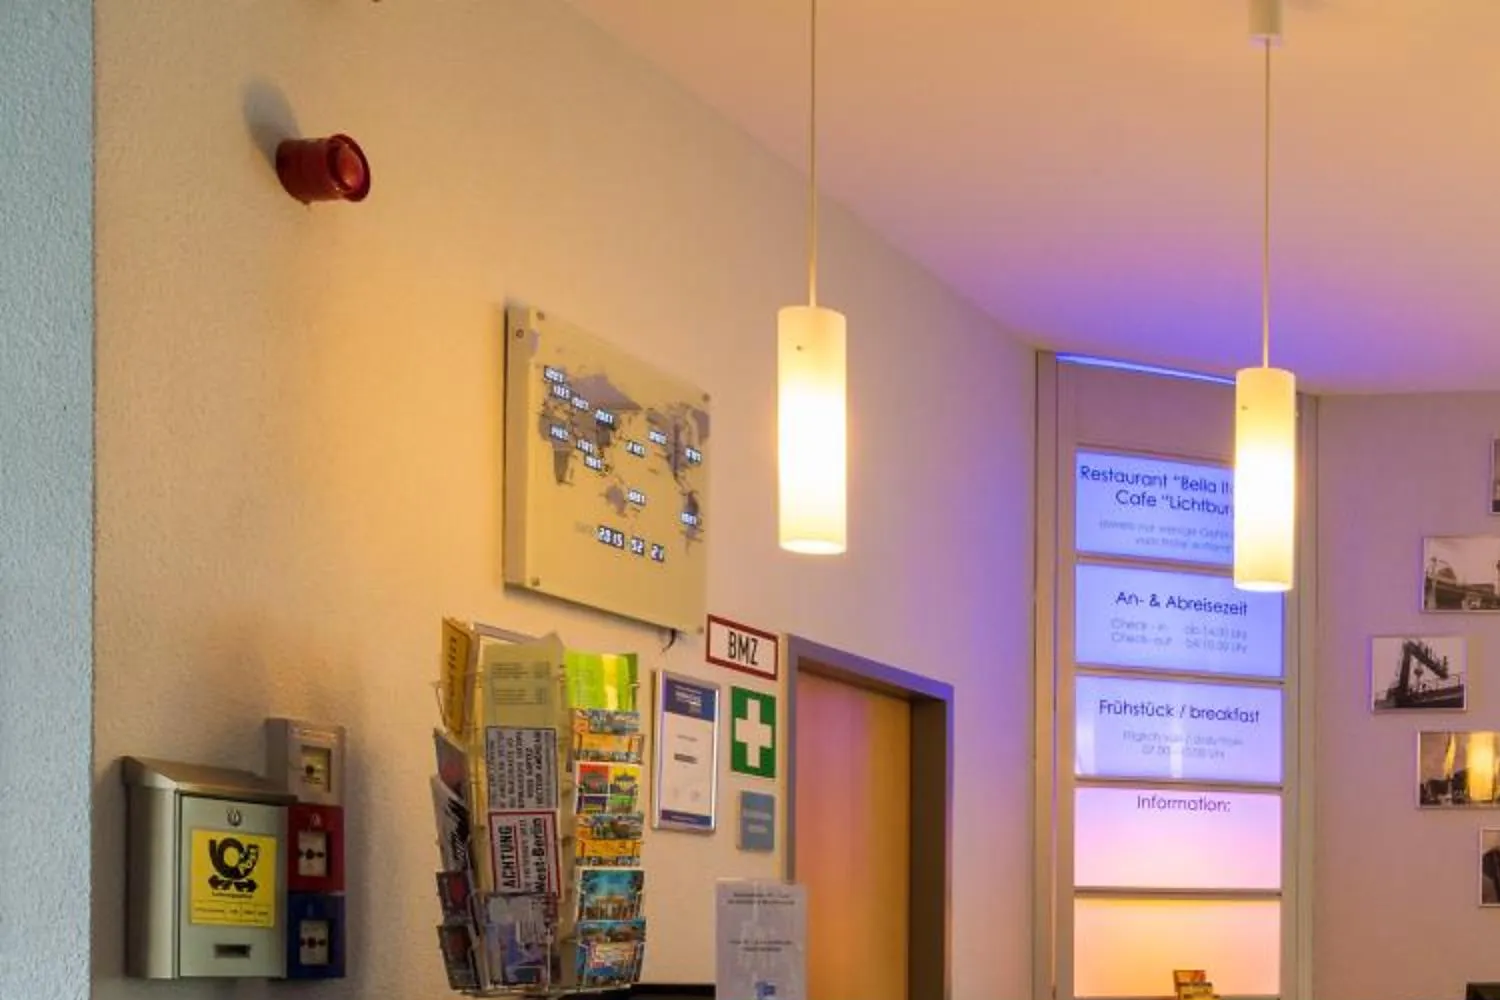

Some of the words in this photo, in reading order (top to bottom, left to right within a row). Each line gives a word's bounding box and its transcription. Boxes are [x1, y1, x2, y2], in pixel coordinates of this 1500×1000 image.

[1080, 465, 1168, 489] Restaurant
[1115, 489, 1157, 507] Cafe
[1161, 494, 1231, 515] "Lichtbur
[1115, 591, 1145, 607] An-
[1148, 593, 1161, 608] &
[1165, 595, 1248, 616] Abreisezeit
[728, 631, 759, 666] BMZ
[1099, 699, 1174, 718] Frühstück
[1178, 703, 1186, 718] /
[1190, 704, 1260, 723] breakfast
[1137, 795, 1232, 813] Information:
[497, 825, 517, 889] ACHTUNG
[531, 817, 547, 893] West-Berlin
